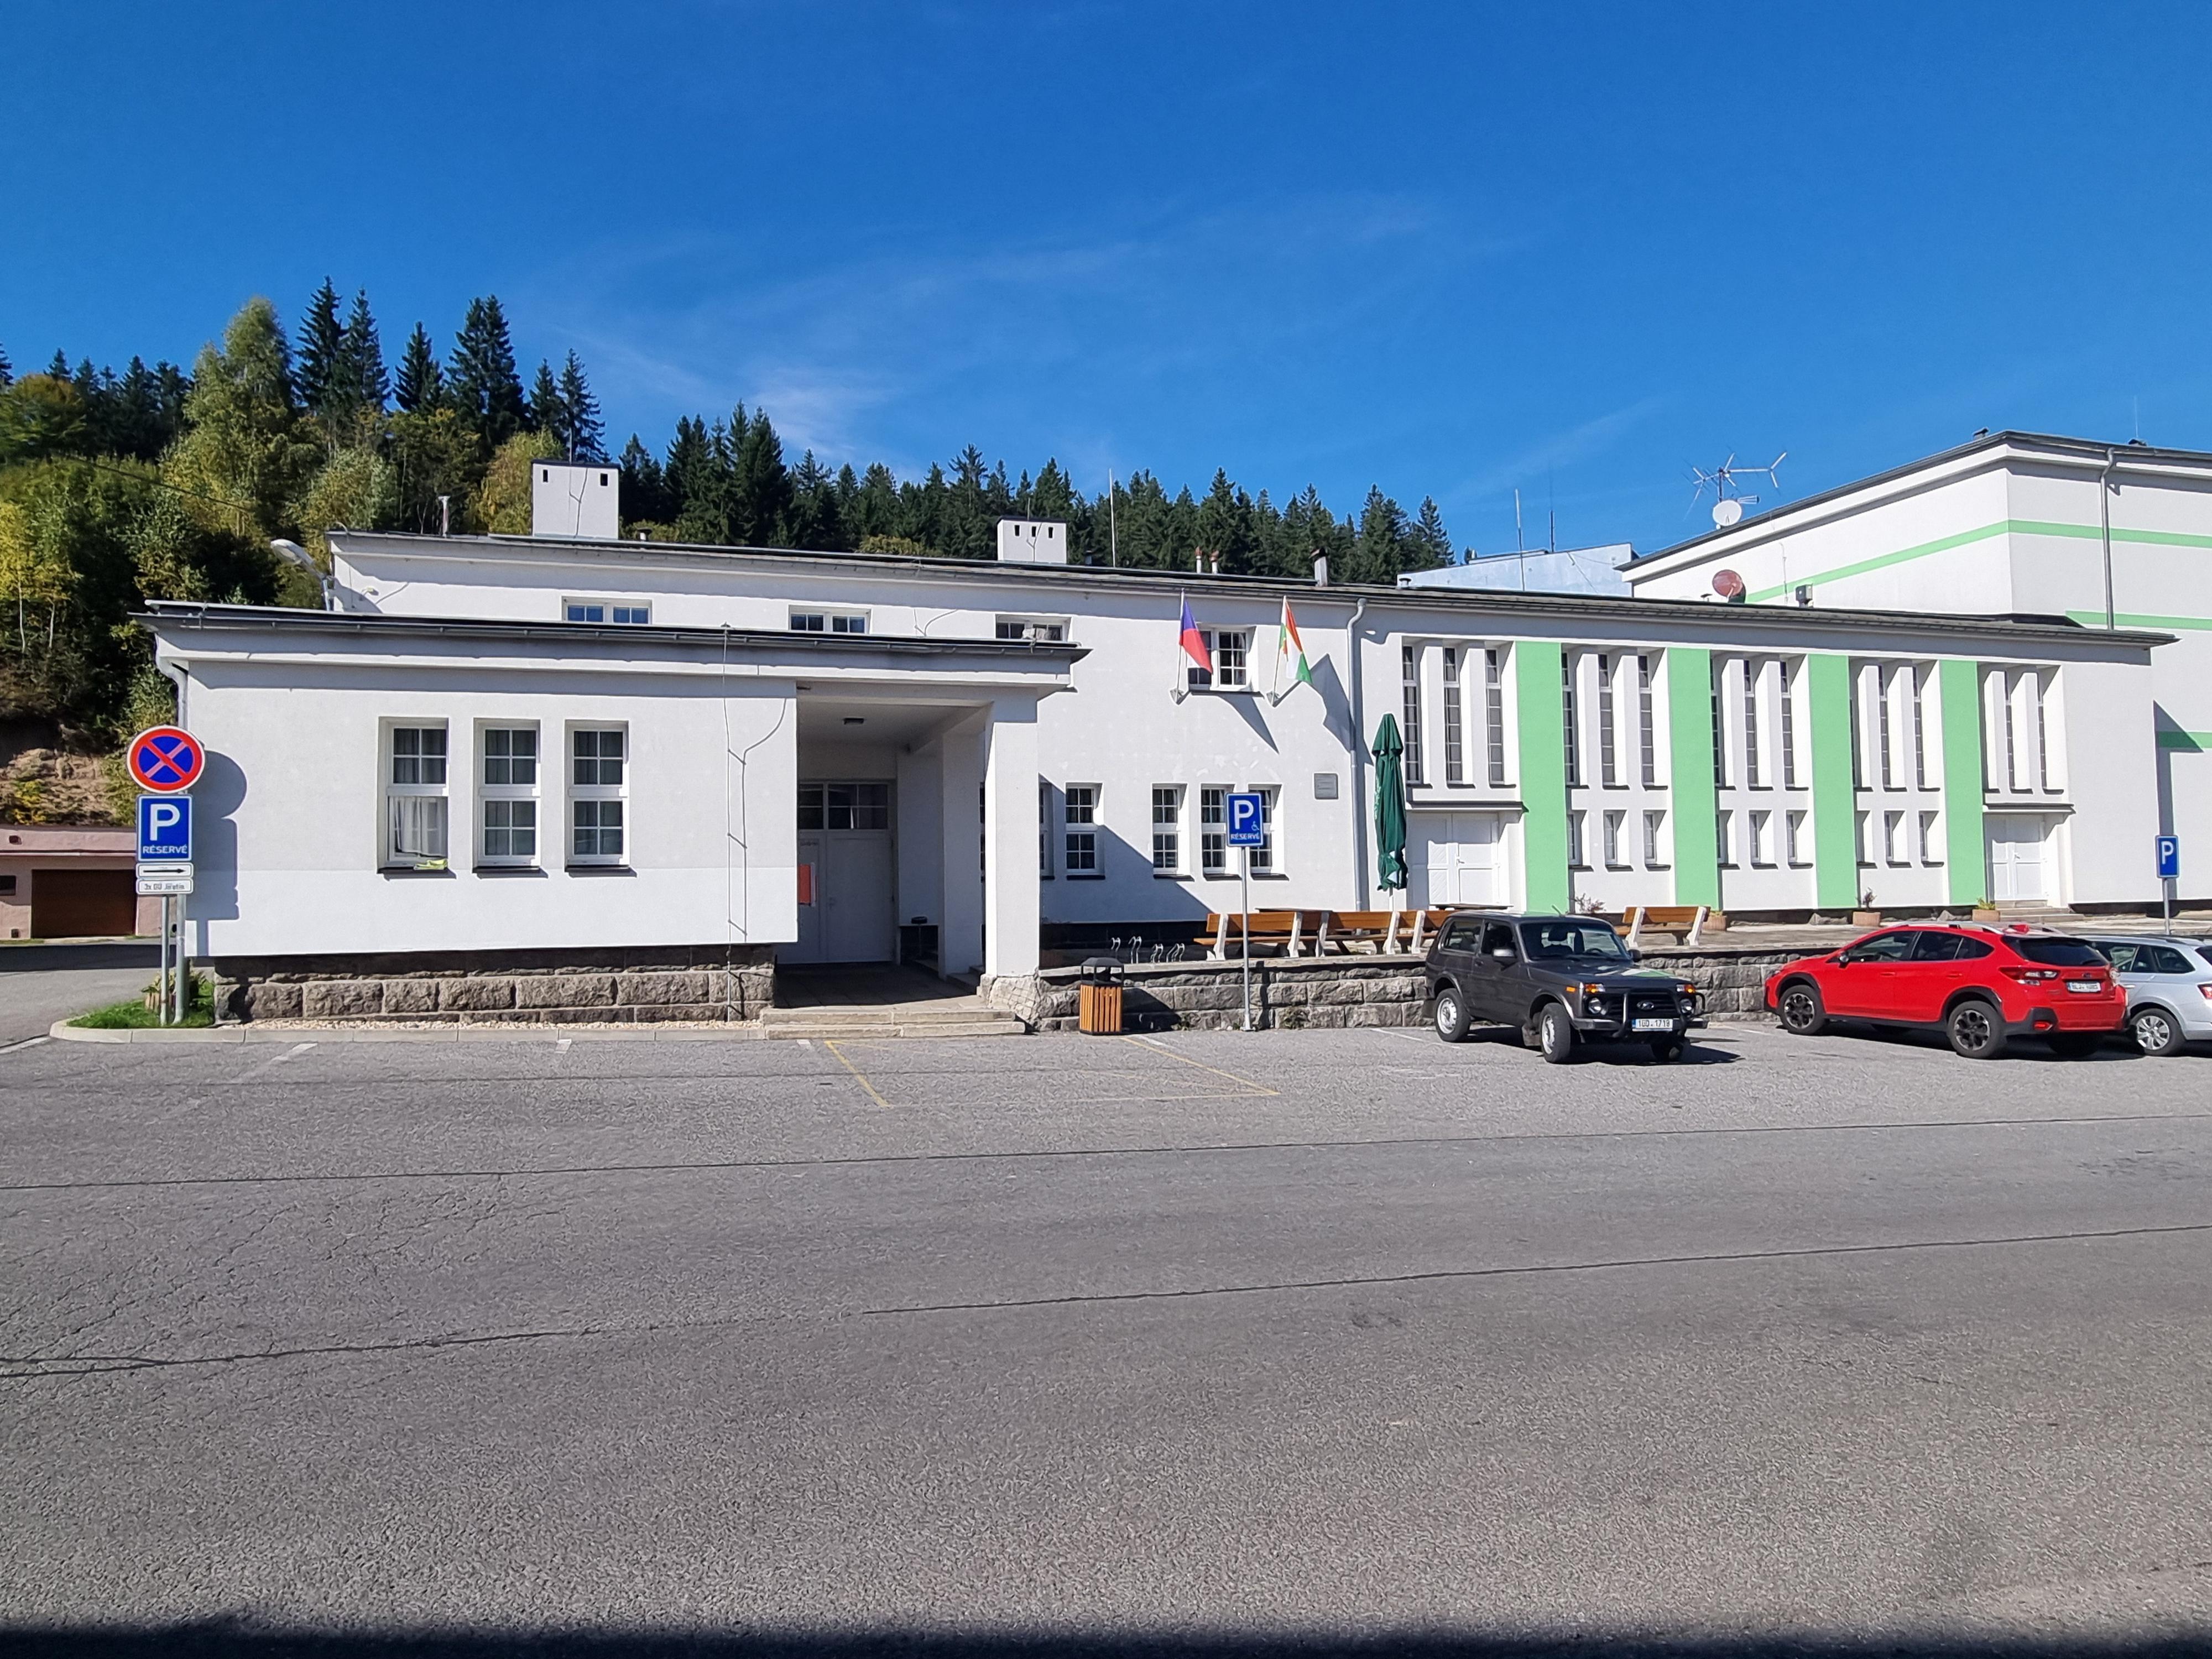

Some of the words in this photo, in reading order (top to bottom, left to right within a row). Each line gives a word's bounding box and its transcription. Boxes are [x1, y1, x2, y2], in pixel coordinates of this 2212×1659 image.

[150, 804, 180, 841] P
[1234, 800, 1254, 830] P
[2161, 841, 2174, 865] P
